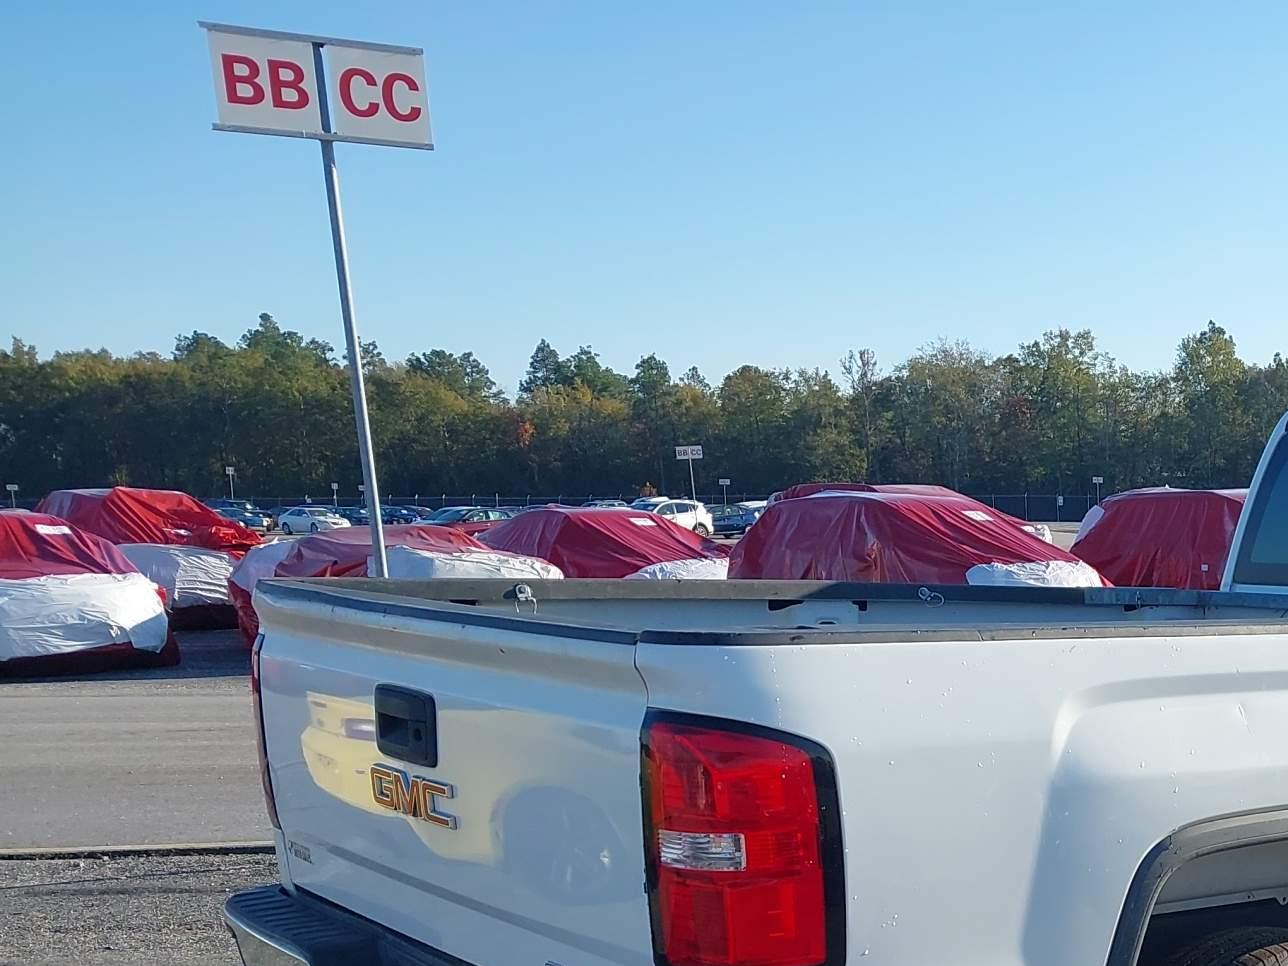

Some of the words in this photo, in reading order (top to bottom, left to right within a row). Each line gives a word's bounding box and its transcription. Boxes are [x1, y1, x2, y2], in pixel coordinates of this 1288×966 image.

[221, 52, 310, 110] BB
[338, 67, 422, 122] CC
[677, 448, 688, 457] BB
[690, 448, 701, 456] CC
[370, 763, 457, 830] GMC
